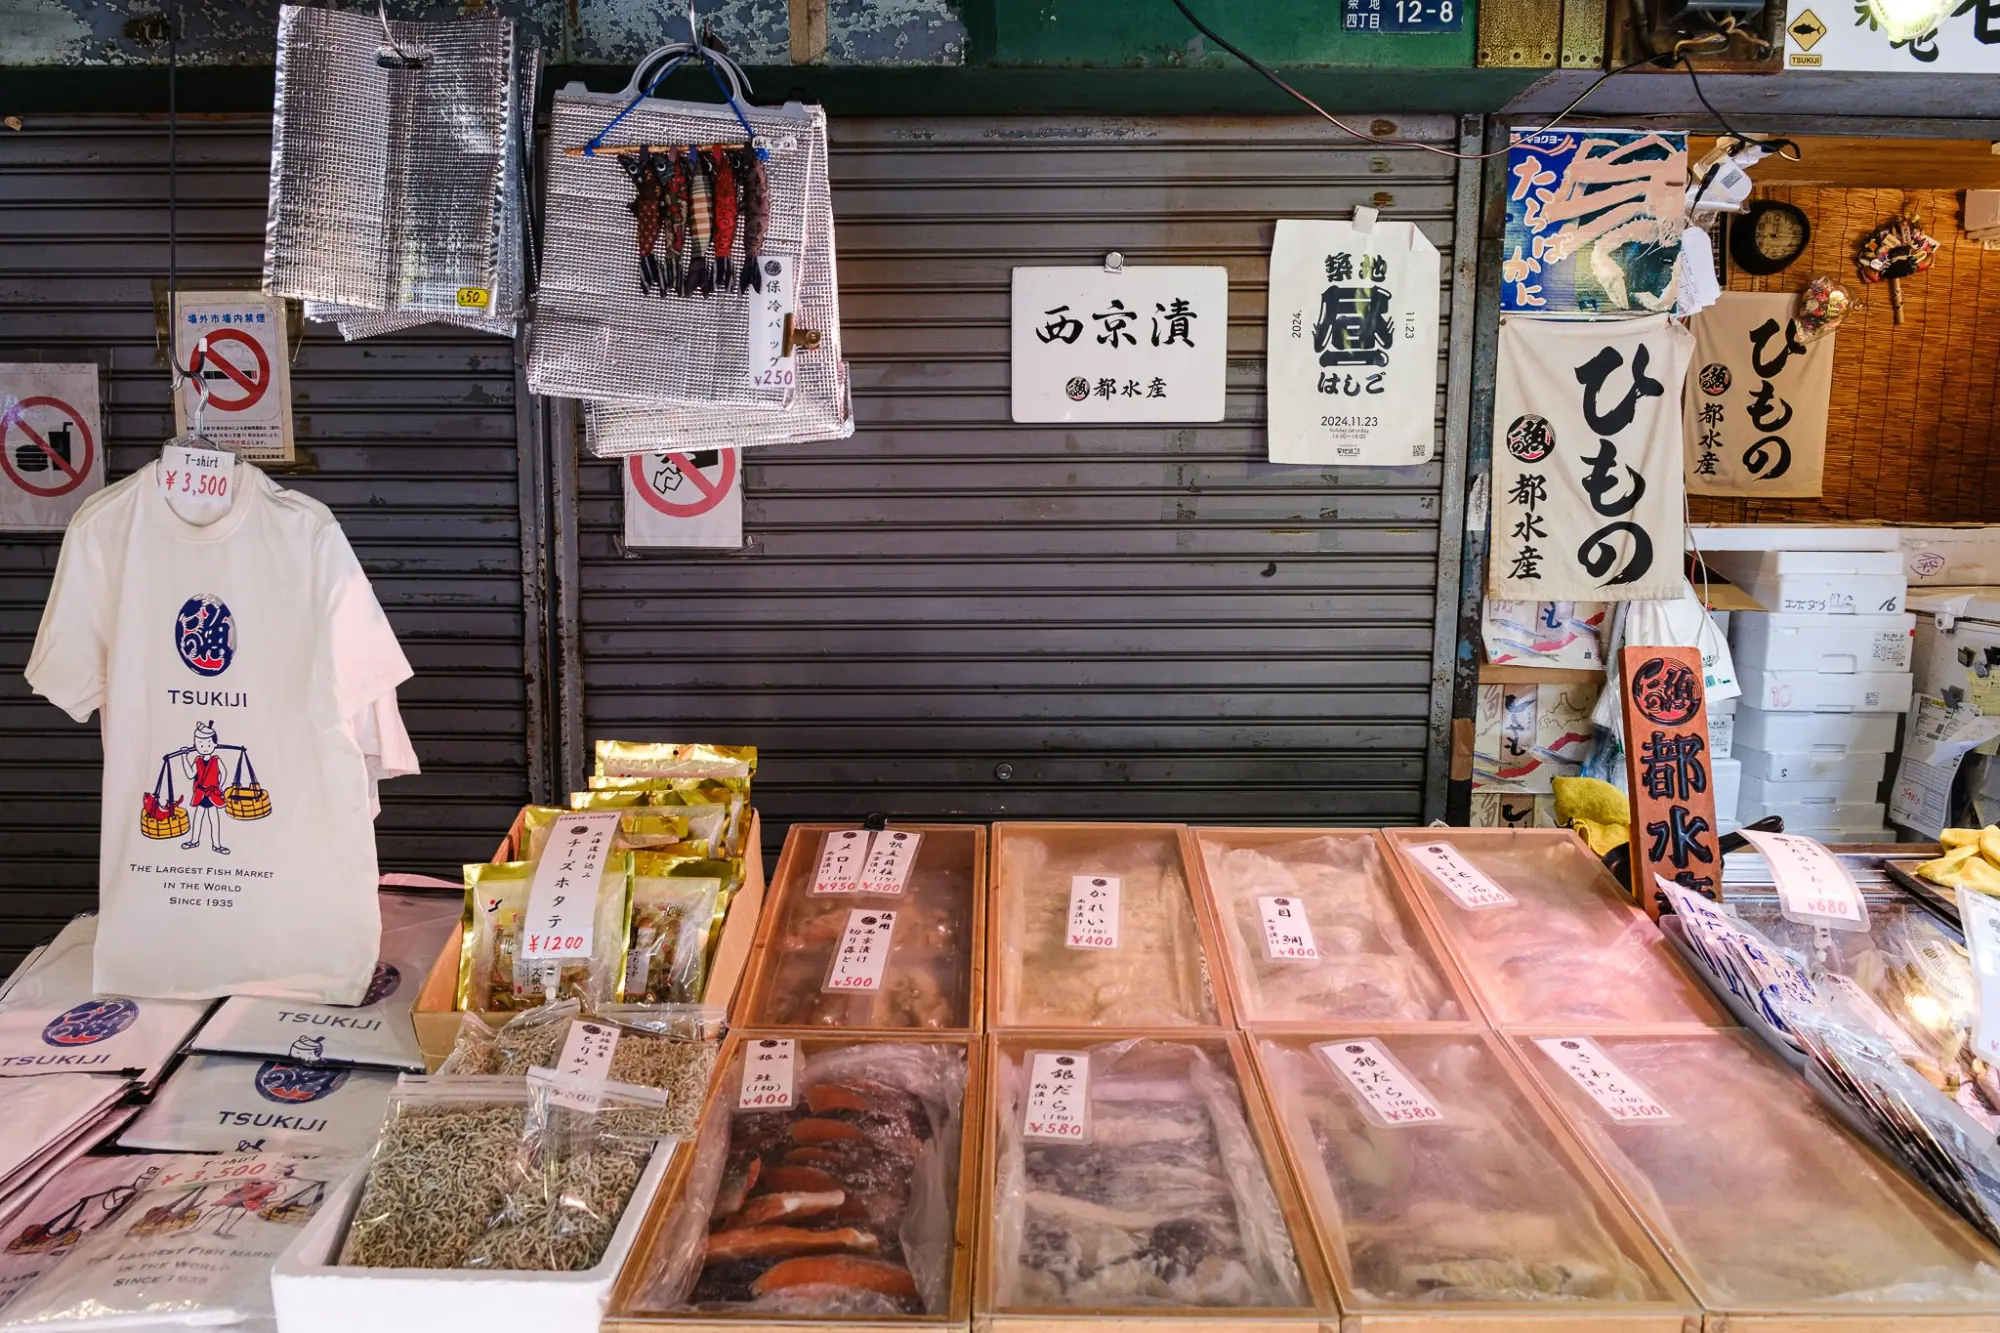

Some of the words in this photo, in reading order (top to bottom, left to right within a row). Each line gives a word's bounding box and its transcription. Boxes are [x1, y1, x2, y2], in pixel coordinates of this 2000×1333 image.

[1395, 0, 1454, 23] 12-8
[1346, 13, 1380, 29] 四丁目
[1325, 252, 1388, 282] 築地
[188, 313, 267, 324] 場外市場内禁煙
[766, 280, 782, 367] 保冷バッグ
[1036, 297, 1198, 349] 西京漬
[1404, 311, 1415, 339] 11.23
[754, 370, 793, 386] ¥250
[1317, 371, 1387, 397] はしご
[1093, 377, 1167, 401] 都水産
[1742, 318, 1807, 481] ひもの
[1321, 416, 1378, 427] 2024.11.23
[1693, 402, 1725, 476] 都水産
[185, 453, 219, 468] T-shirt
[1574, 343, 1665, 590] ひもの
[1507, 473, 1549, 580] 都水産
[1878, 596, 1897, 612] 16
[168, 689, 248, 707] TSUKIJI
[130, 864, 152, 873] THE
[156, 865, 203, 875] LARGEST
[206, 867, 232, 876] FISH
[234, 869, 275, 879] MARKET
[180, 882, 200, 891] THE
[204, 883, 242, 892] WORLD
[548, 838, 581, 929] チーズホタテ
[817, 882, 857, 891] ¥950
[862, 882, 901, 892] ¥500
[169, 897, 202, 906] SINCE
[206, 898, 234, 908] 1935
[1807, 899, 1848, 914] ¥680
[878, 912, 894, 930] 徳用
[856, 929, 875, 964] 西京漬け
[1072, 935, 1113, 946] ¥400
[1279, 947, 1315, 957] ¥400
[834, 977, 873, 987] ¥500
[277, 1011, 383, 1031] TSUKIJI
[1, 1054, 111, 1066] TSUKIJI
[743, 1093, 788, 1105] ¥400
[218, 1111, 329, 1132] TSUKIJI
[1384, 1107, 1437, 1121] ¥580
[1029, 1122, 1081, 1135] ¥580
